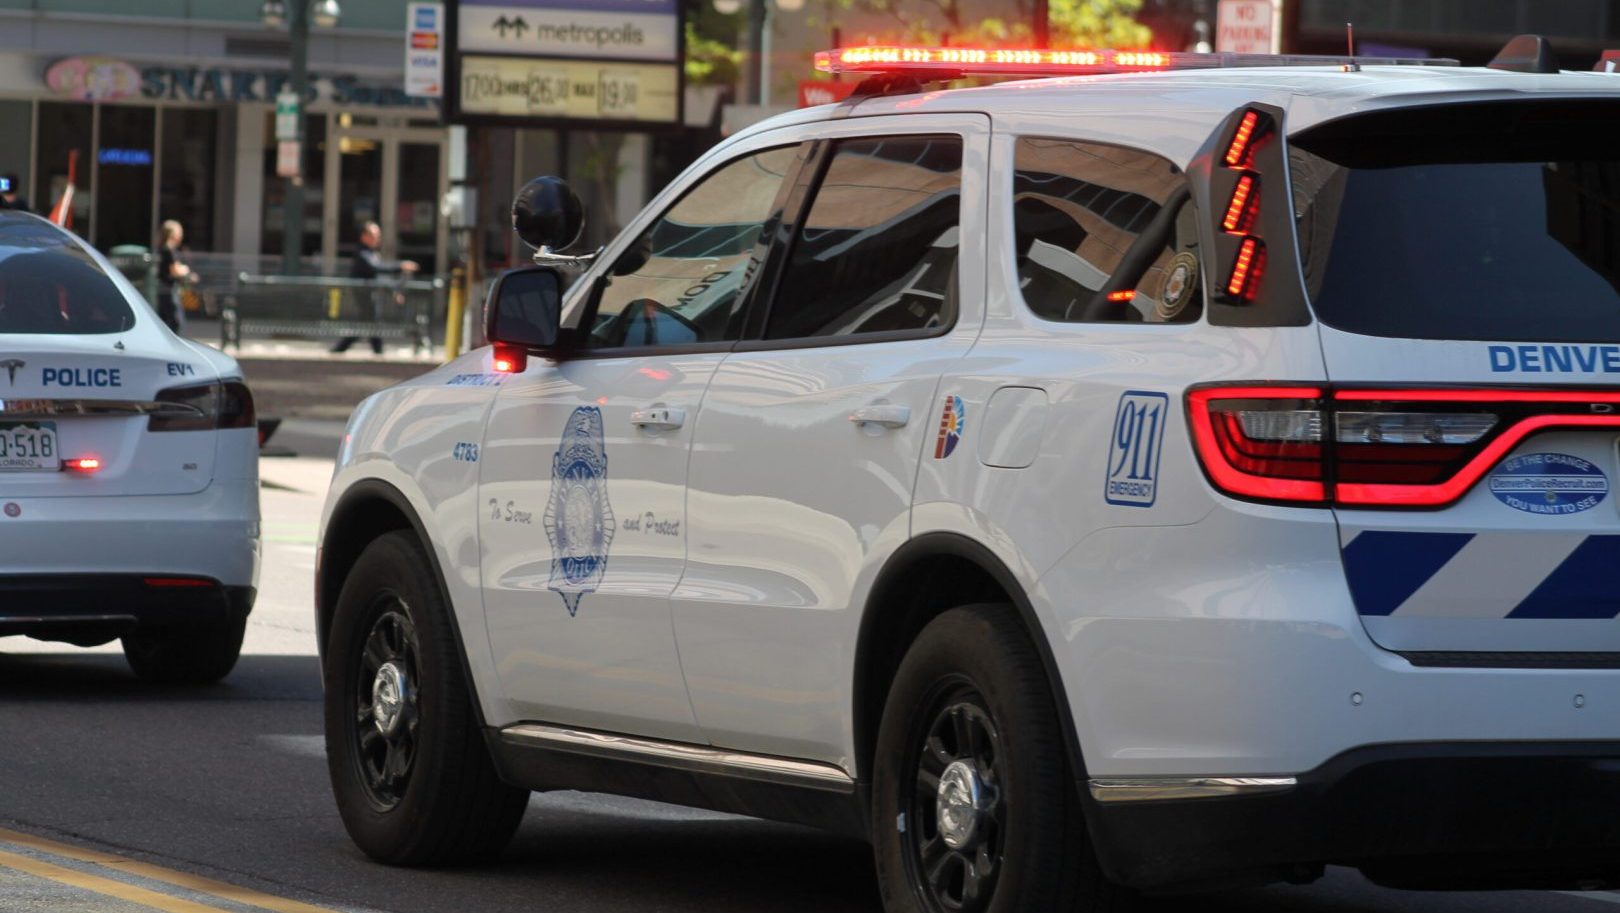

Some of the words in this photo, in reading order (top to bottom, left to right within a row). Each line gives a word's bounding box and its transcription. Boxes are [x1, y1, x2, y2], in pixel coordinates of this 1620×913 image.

[1236, 6, 1255, 20] NO
[537, 22, 645, 48] metropolis
[42, 368, 121, 387] POLICE
[167, 363, 195, 376] EV1
[1111, 400, 1161, 480] 911
[453, 442, 479, 461] 4783
[1505, 459, 1520, 471] BE
[1522, 454, 1543, 466] THE
[1544, 454, 1590, 472] CHANGE
[1110, 481, 1152, 496] EMERGENCY
[1493, 478, 1606, 489] DenverPoliceRecruit.com
[489, 498, 501, 520] To
[505, 500, 532, 524] Serve
[1506, 495, 1528, 510] YOU
[1529, 503, 1560, 513] WANT
[1561, 503, 1576, 513] TO
[1576, 495, 1598, 510] SEE
[622, 512, 641, 531] and
[644, 511, 680, 537] Protect
